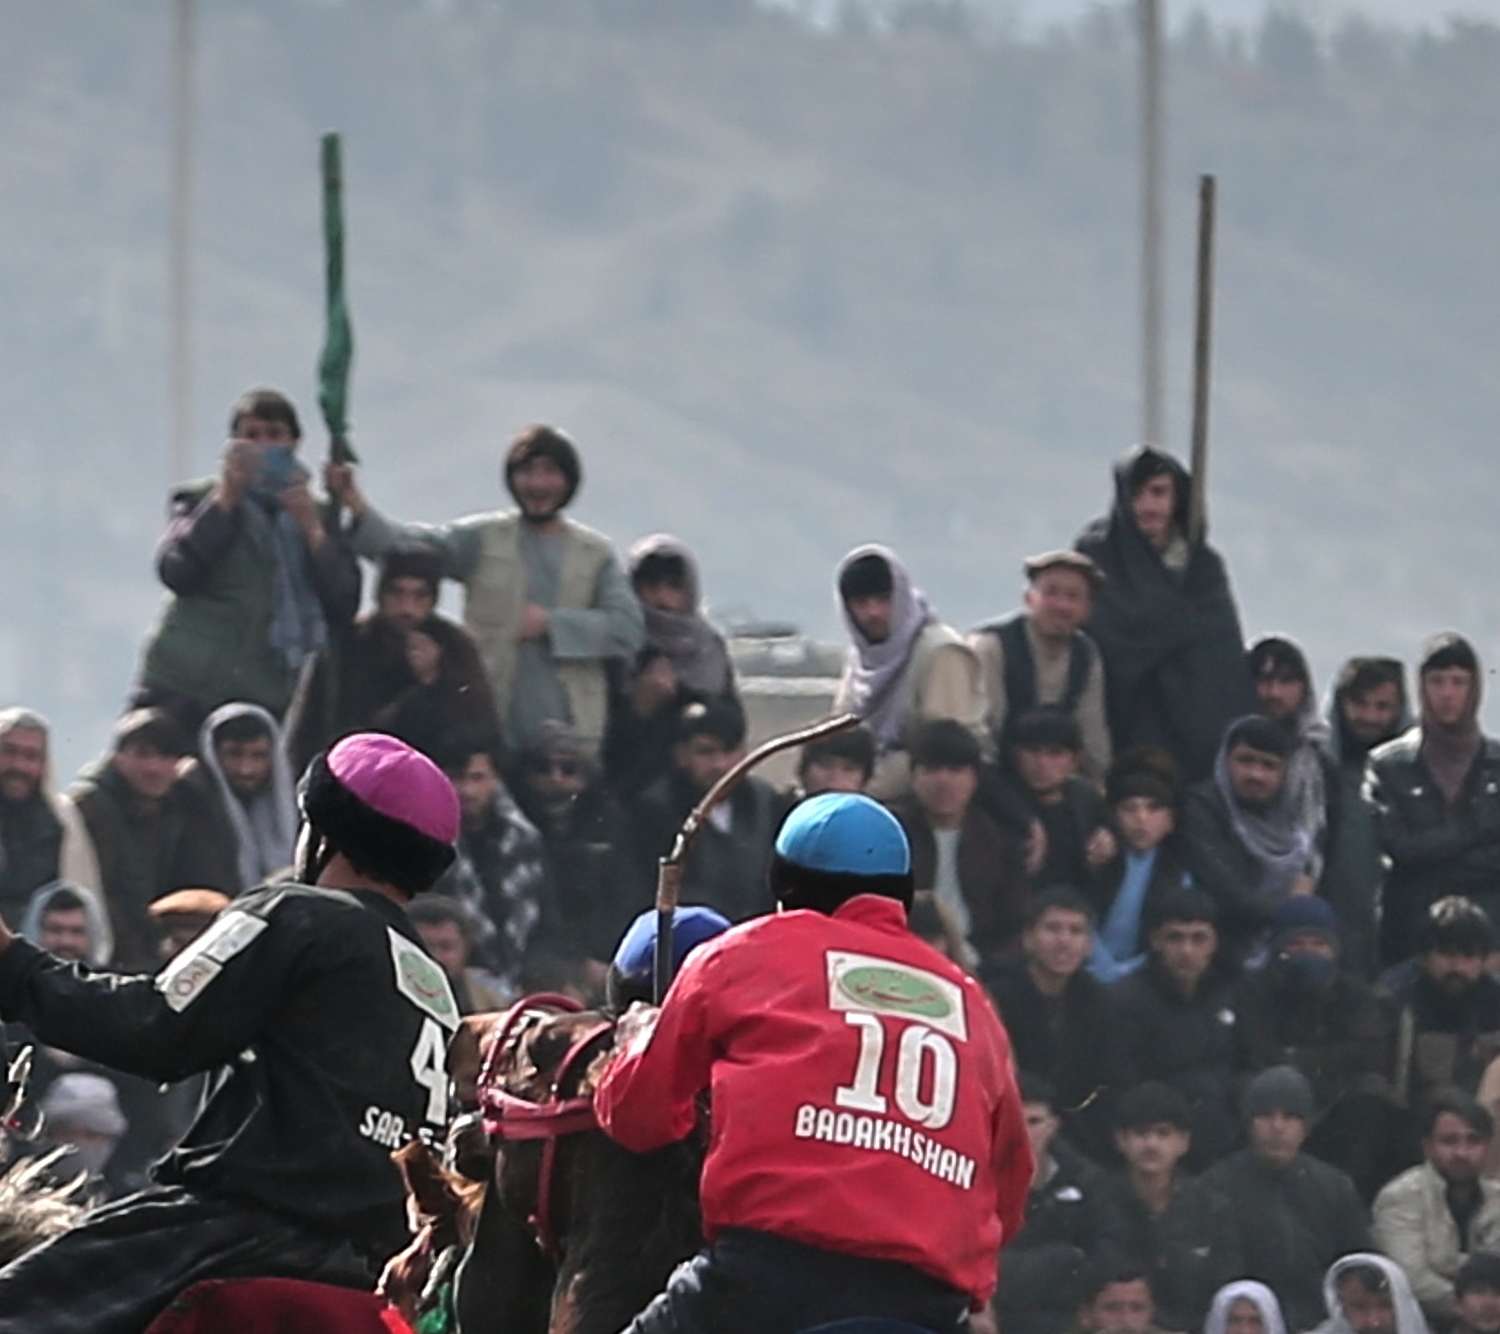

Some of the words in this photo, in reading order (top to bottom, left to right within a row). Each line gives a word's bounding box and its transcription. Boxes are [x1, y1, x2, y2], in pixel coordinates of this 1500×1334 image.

[410, 1017, 449, 1126] 4
[835, 1012, 957, 1130] 10
[359, 1105, 446, 1152] SAR-E-
[795, 1105, 975, 1189] BADAKHSHAN
